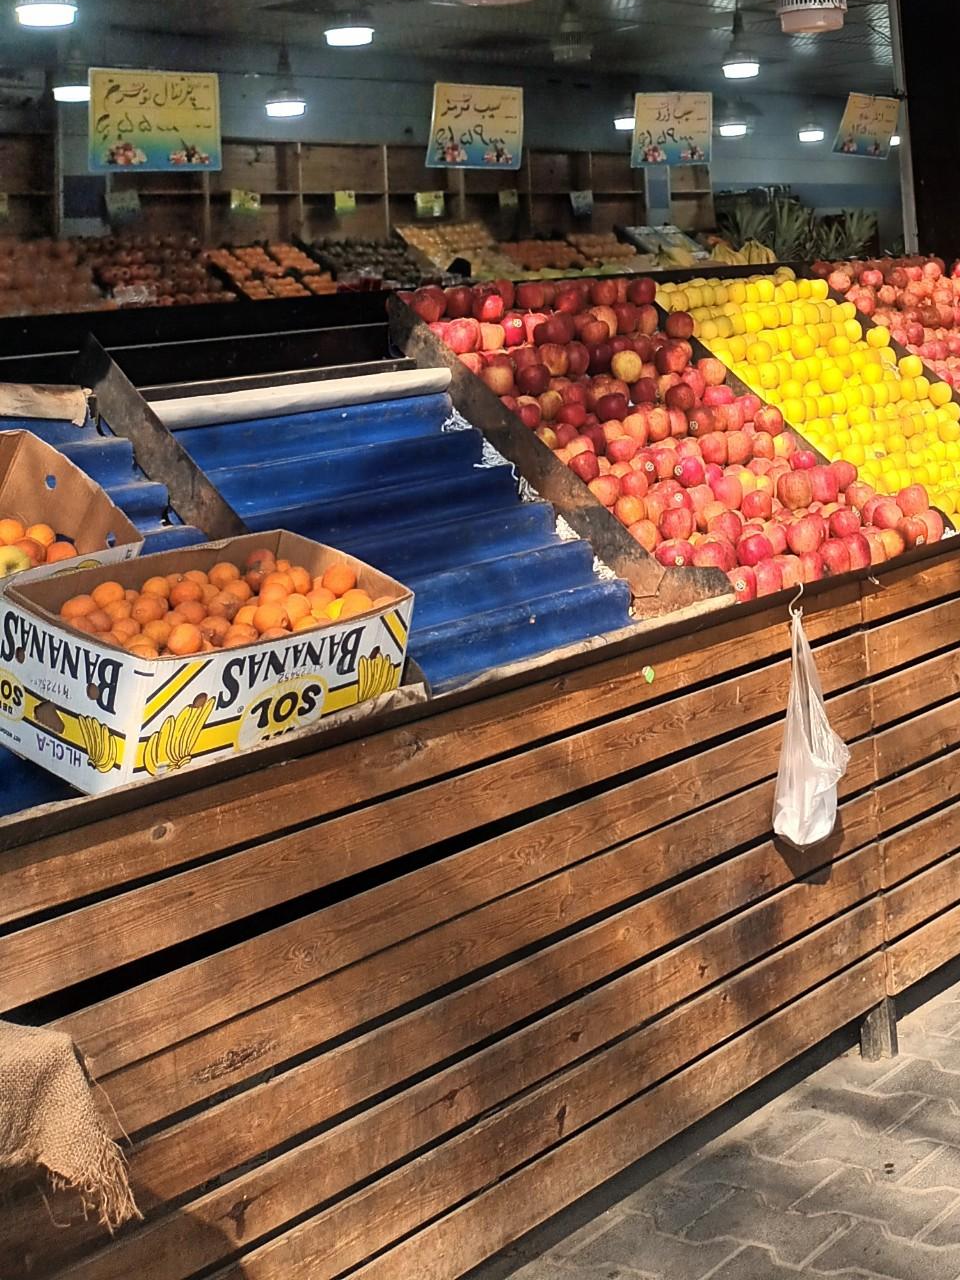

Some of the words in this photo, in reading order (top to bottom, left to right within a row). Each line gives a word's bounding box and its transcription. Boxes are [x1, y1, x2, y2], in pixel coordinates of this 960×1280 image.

[440, 98, 471, 119] قرمز
[473, 102, 502, 120] سیب
[673, 109, 694, 124] سیب
[0, 611, 124, 715] BANANAS
[213, 626, 365, 716] BANANAS
[0, 679, 24, 707] SO
[249, 684, 323, 721] SOL
[36, 733, 82, 767] HLCL-A
